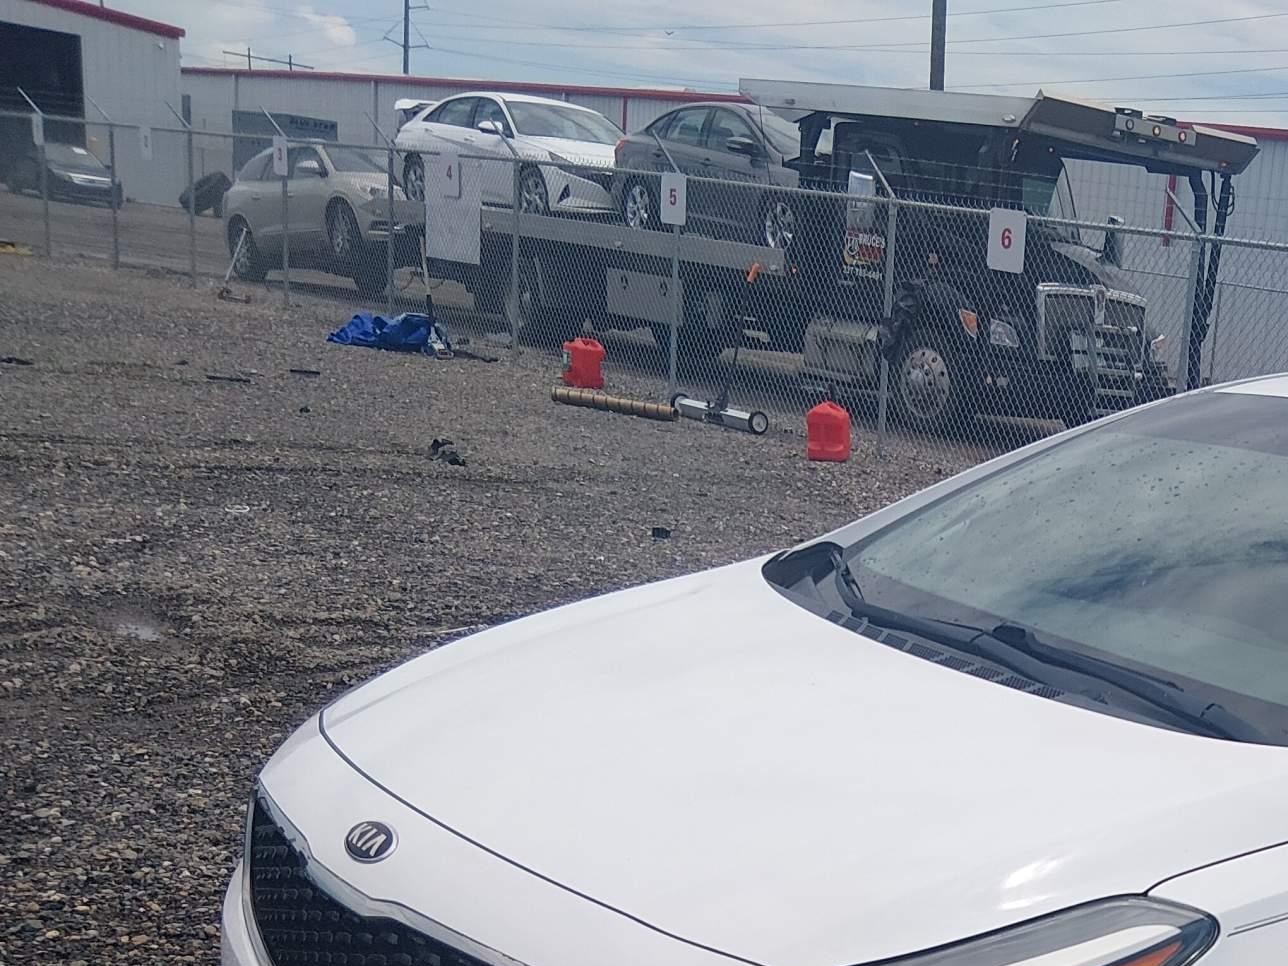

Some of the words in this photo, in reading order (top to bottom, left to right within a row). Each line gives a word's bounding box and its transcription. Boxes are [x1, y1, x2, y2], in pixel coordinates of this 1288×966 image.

[446, 164, 453, 181] 4
[669, 187, 677, 206] 5
[1001, 227, 1012, 249] 6
[348, 822, 388, 857] KIA
